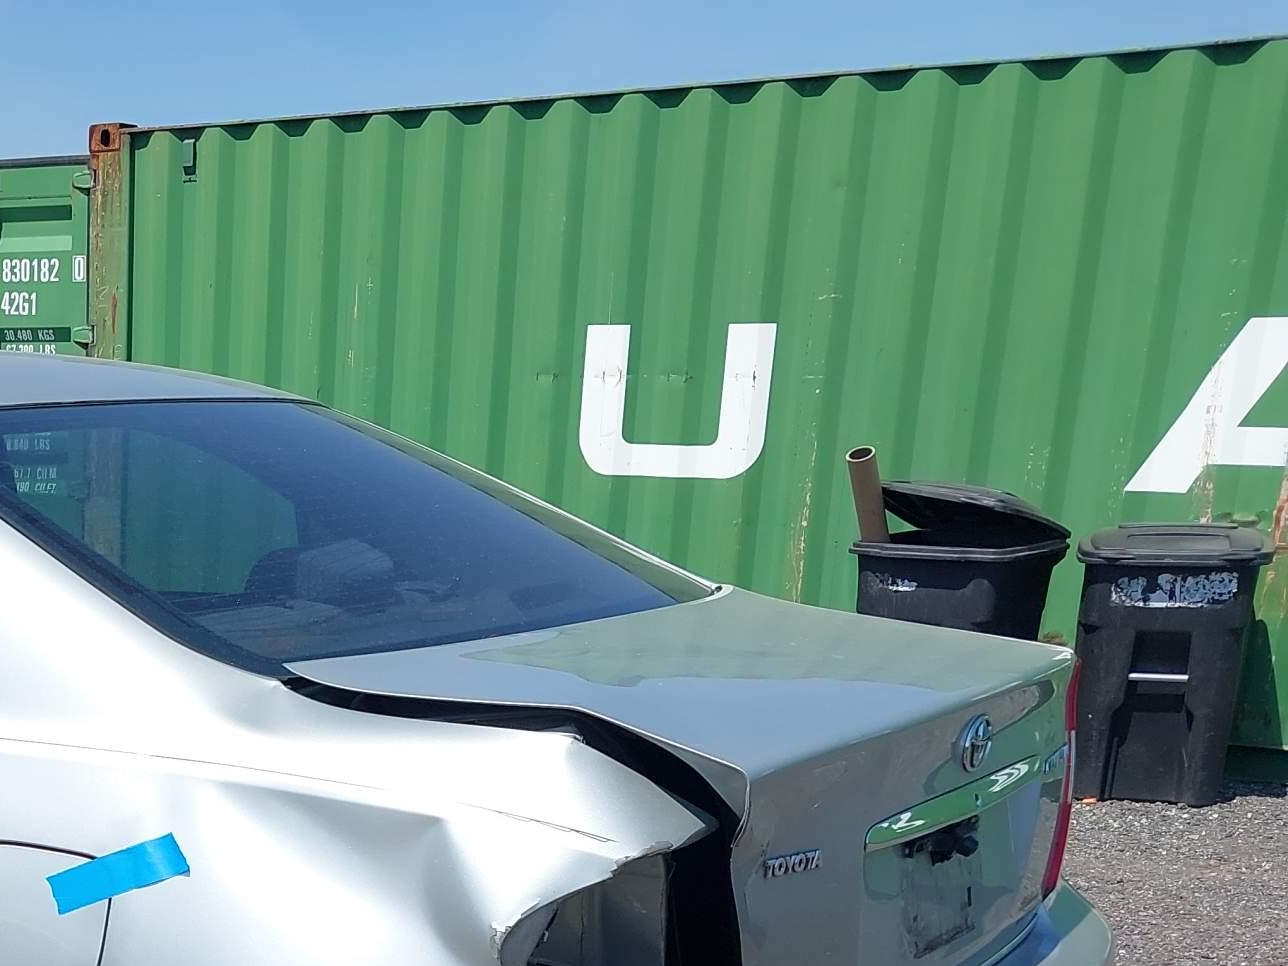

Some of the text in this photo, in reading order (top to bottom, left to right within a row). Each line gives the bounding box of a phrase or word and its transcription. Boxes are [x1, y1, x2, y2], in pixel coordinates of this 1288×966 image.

[2, 258, 60, 283] 830182
[73, 256, 85, 280] 0
[0, 291, 37, 316] 42G1
[37, 329, 55, 341] KGS
[765, 849, 824, 879] TOYOTA
